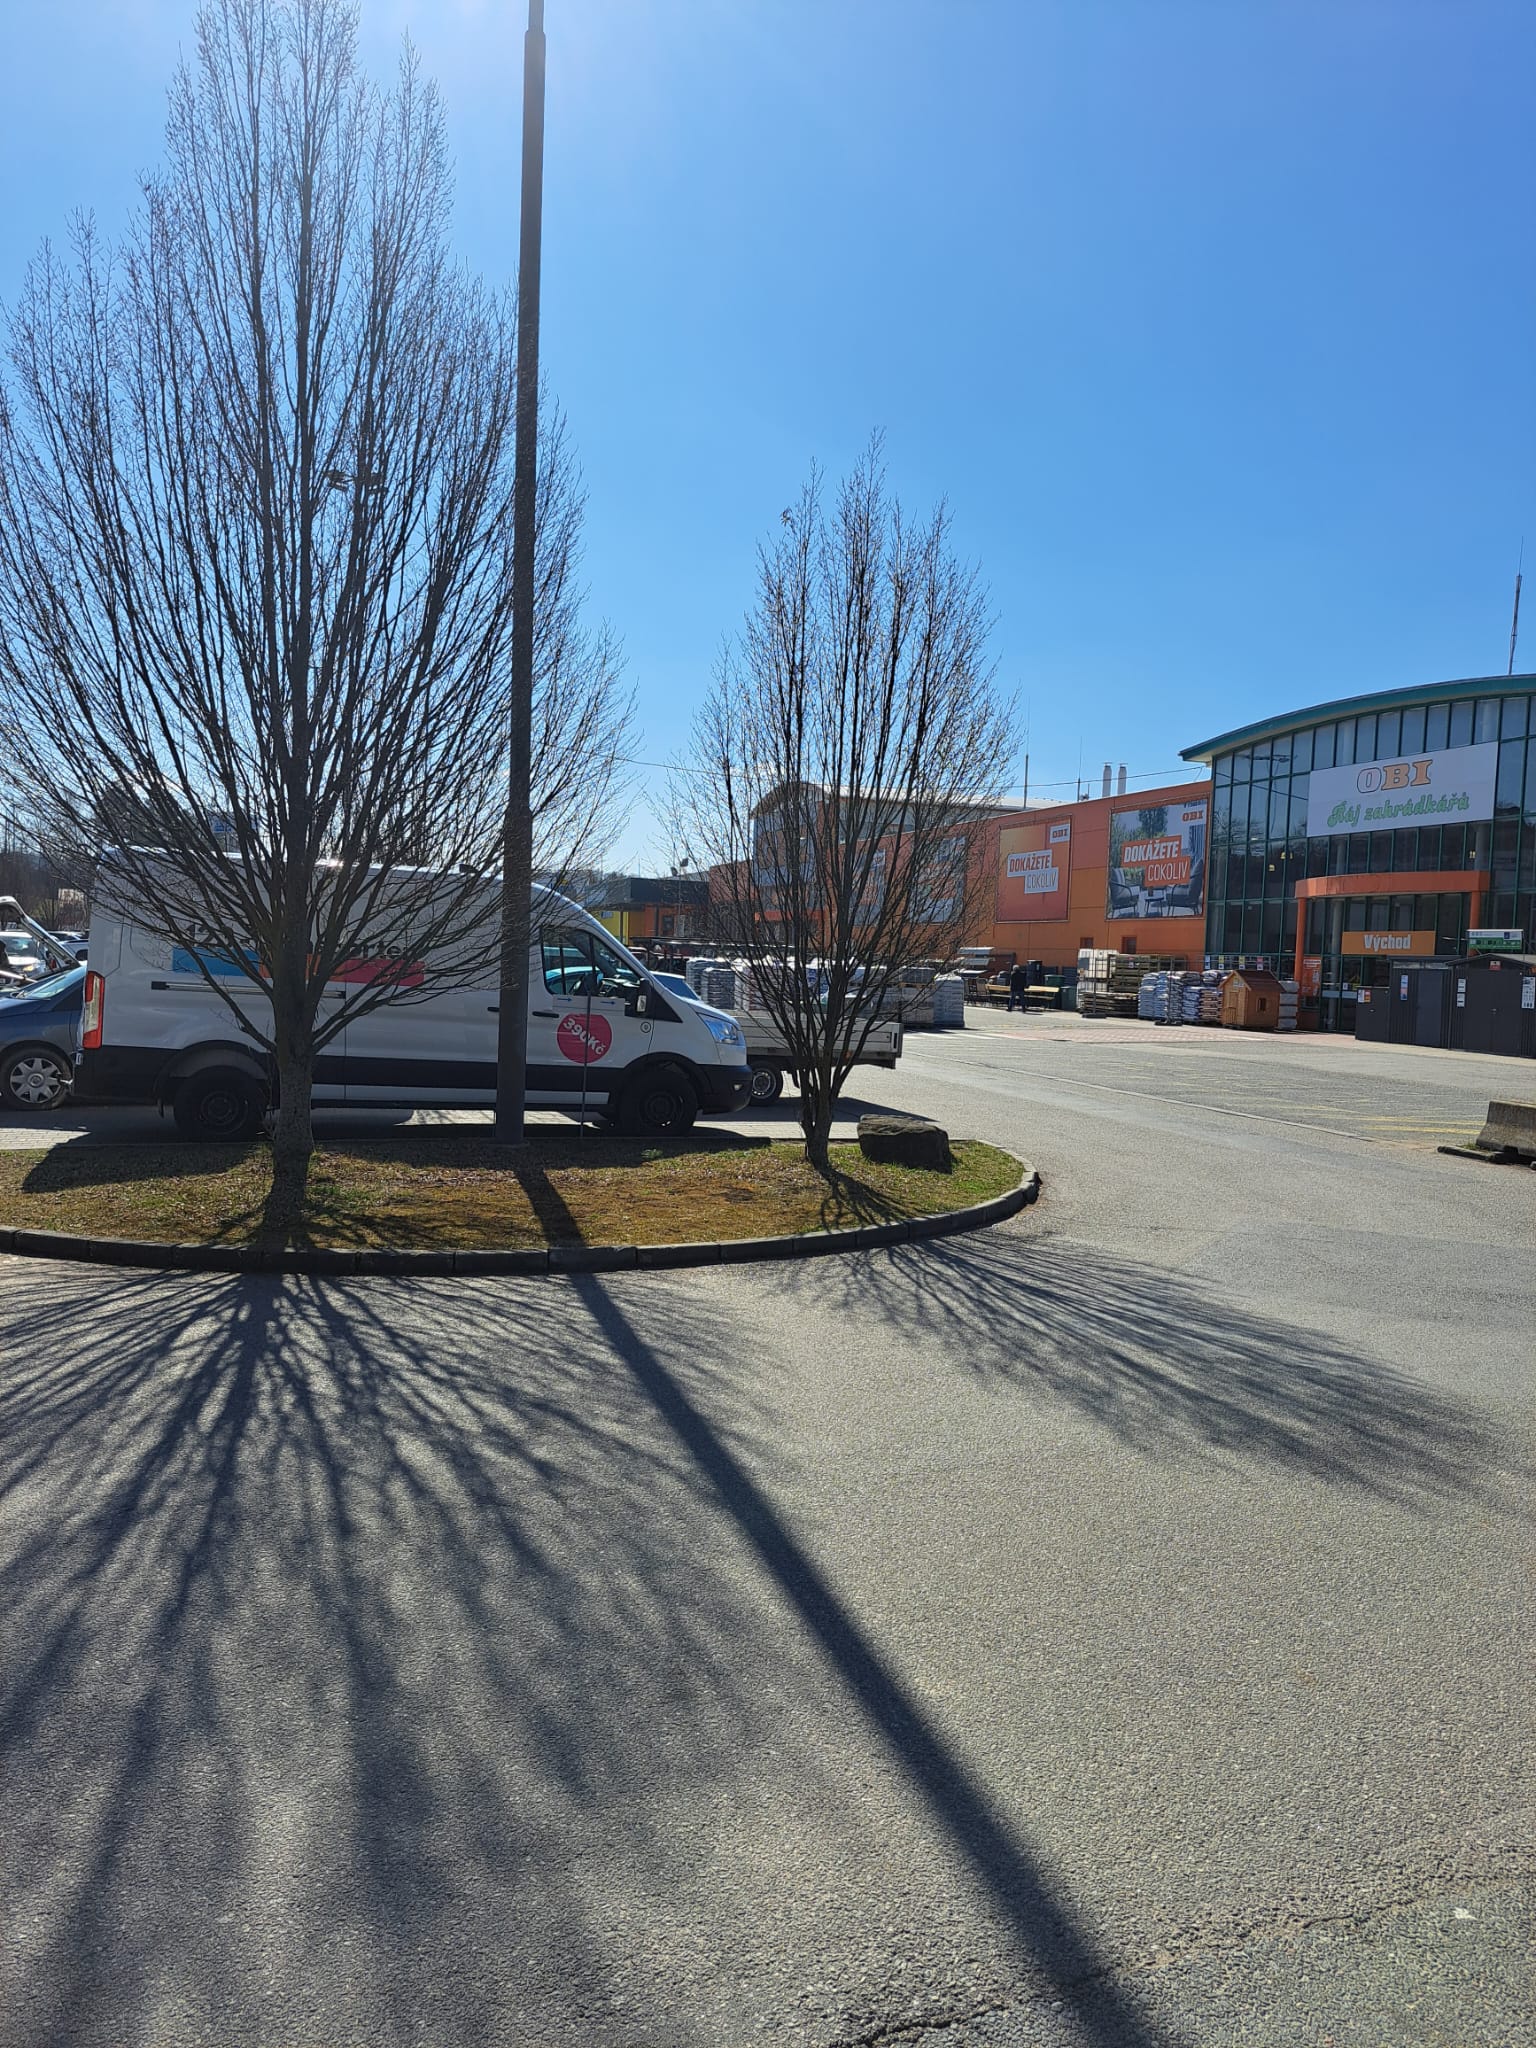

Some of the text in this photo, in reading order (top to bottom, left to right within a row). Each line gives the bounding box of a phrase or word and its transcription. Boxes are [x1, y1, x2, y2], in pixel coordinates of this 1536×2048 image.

[1356, 759, 1433, 793] OBI
[1124, 840, 1179, 862] DOKÁŽETE
[1010, 853, 1051, 872] DOKÁŽETE
[1148, 861, 1188, 882] COKOLIV
[1027, 871, 1057, 889] COKOLIV
[1364, 934, 1411, 952] Východ
